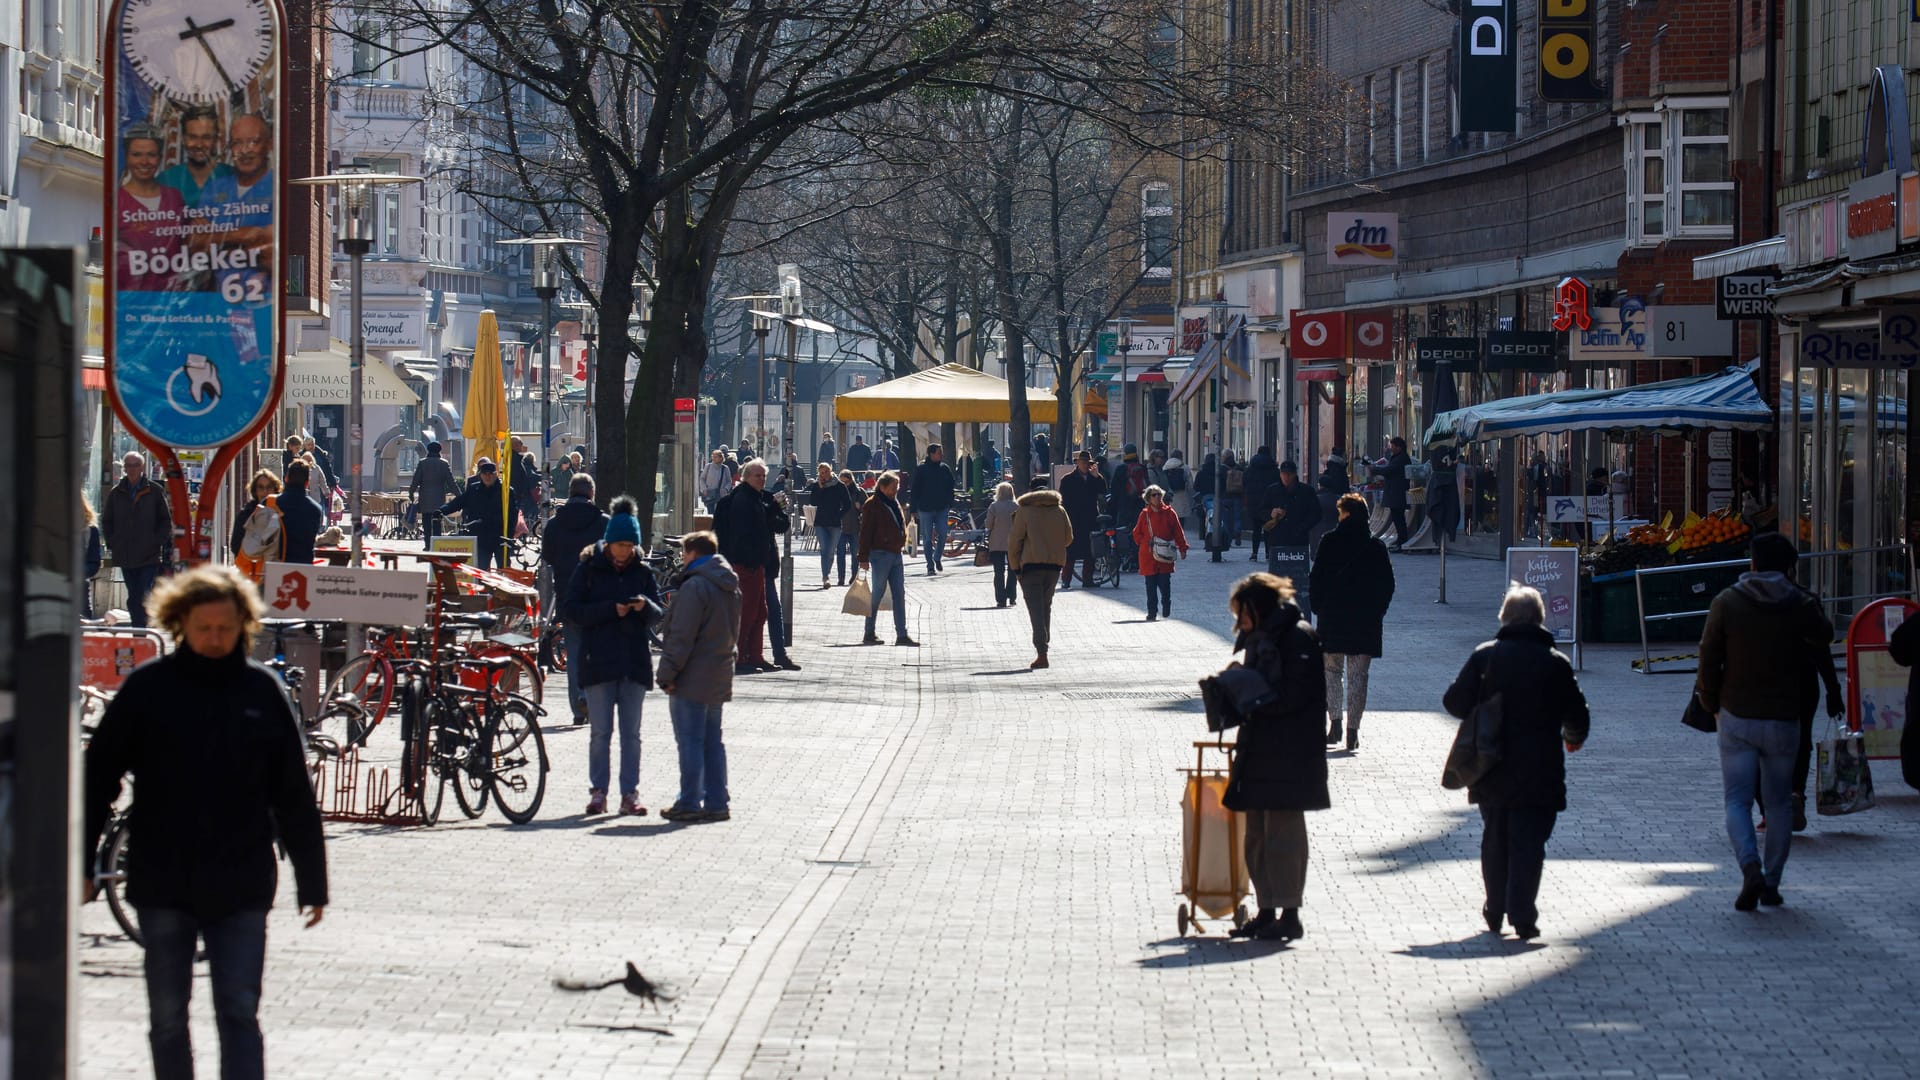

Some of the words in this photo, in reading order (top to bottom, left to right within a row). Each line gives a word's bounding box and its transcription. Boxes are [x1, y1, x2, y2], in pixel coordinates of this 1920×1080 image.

[122, 208, 181, 223] Schöne,
[183, 205, 220, 219] feste
[223, 202, 270, 216] Zähne
[1345, 219, 1387, 244] dm
[128, 243, 262, 276] Bödeker
[221, 273, 265, 303] 62
[361, 321, 404, 336] Sprengel
[1666, 321, 1686, 341] 81
[1421, 350, 1475, 358] DEPOT
[1490, 345, 1550, 354] DEPOT
[1528, 560, 1560, 572] Kaffee
[1524, 572, 1562, 585] Genuss
